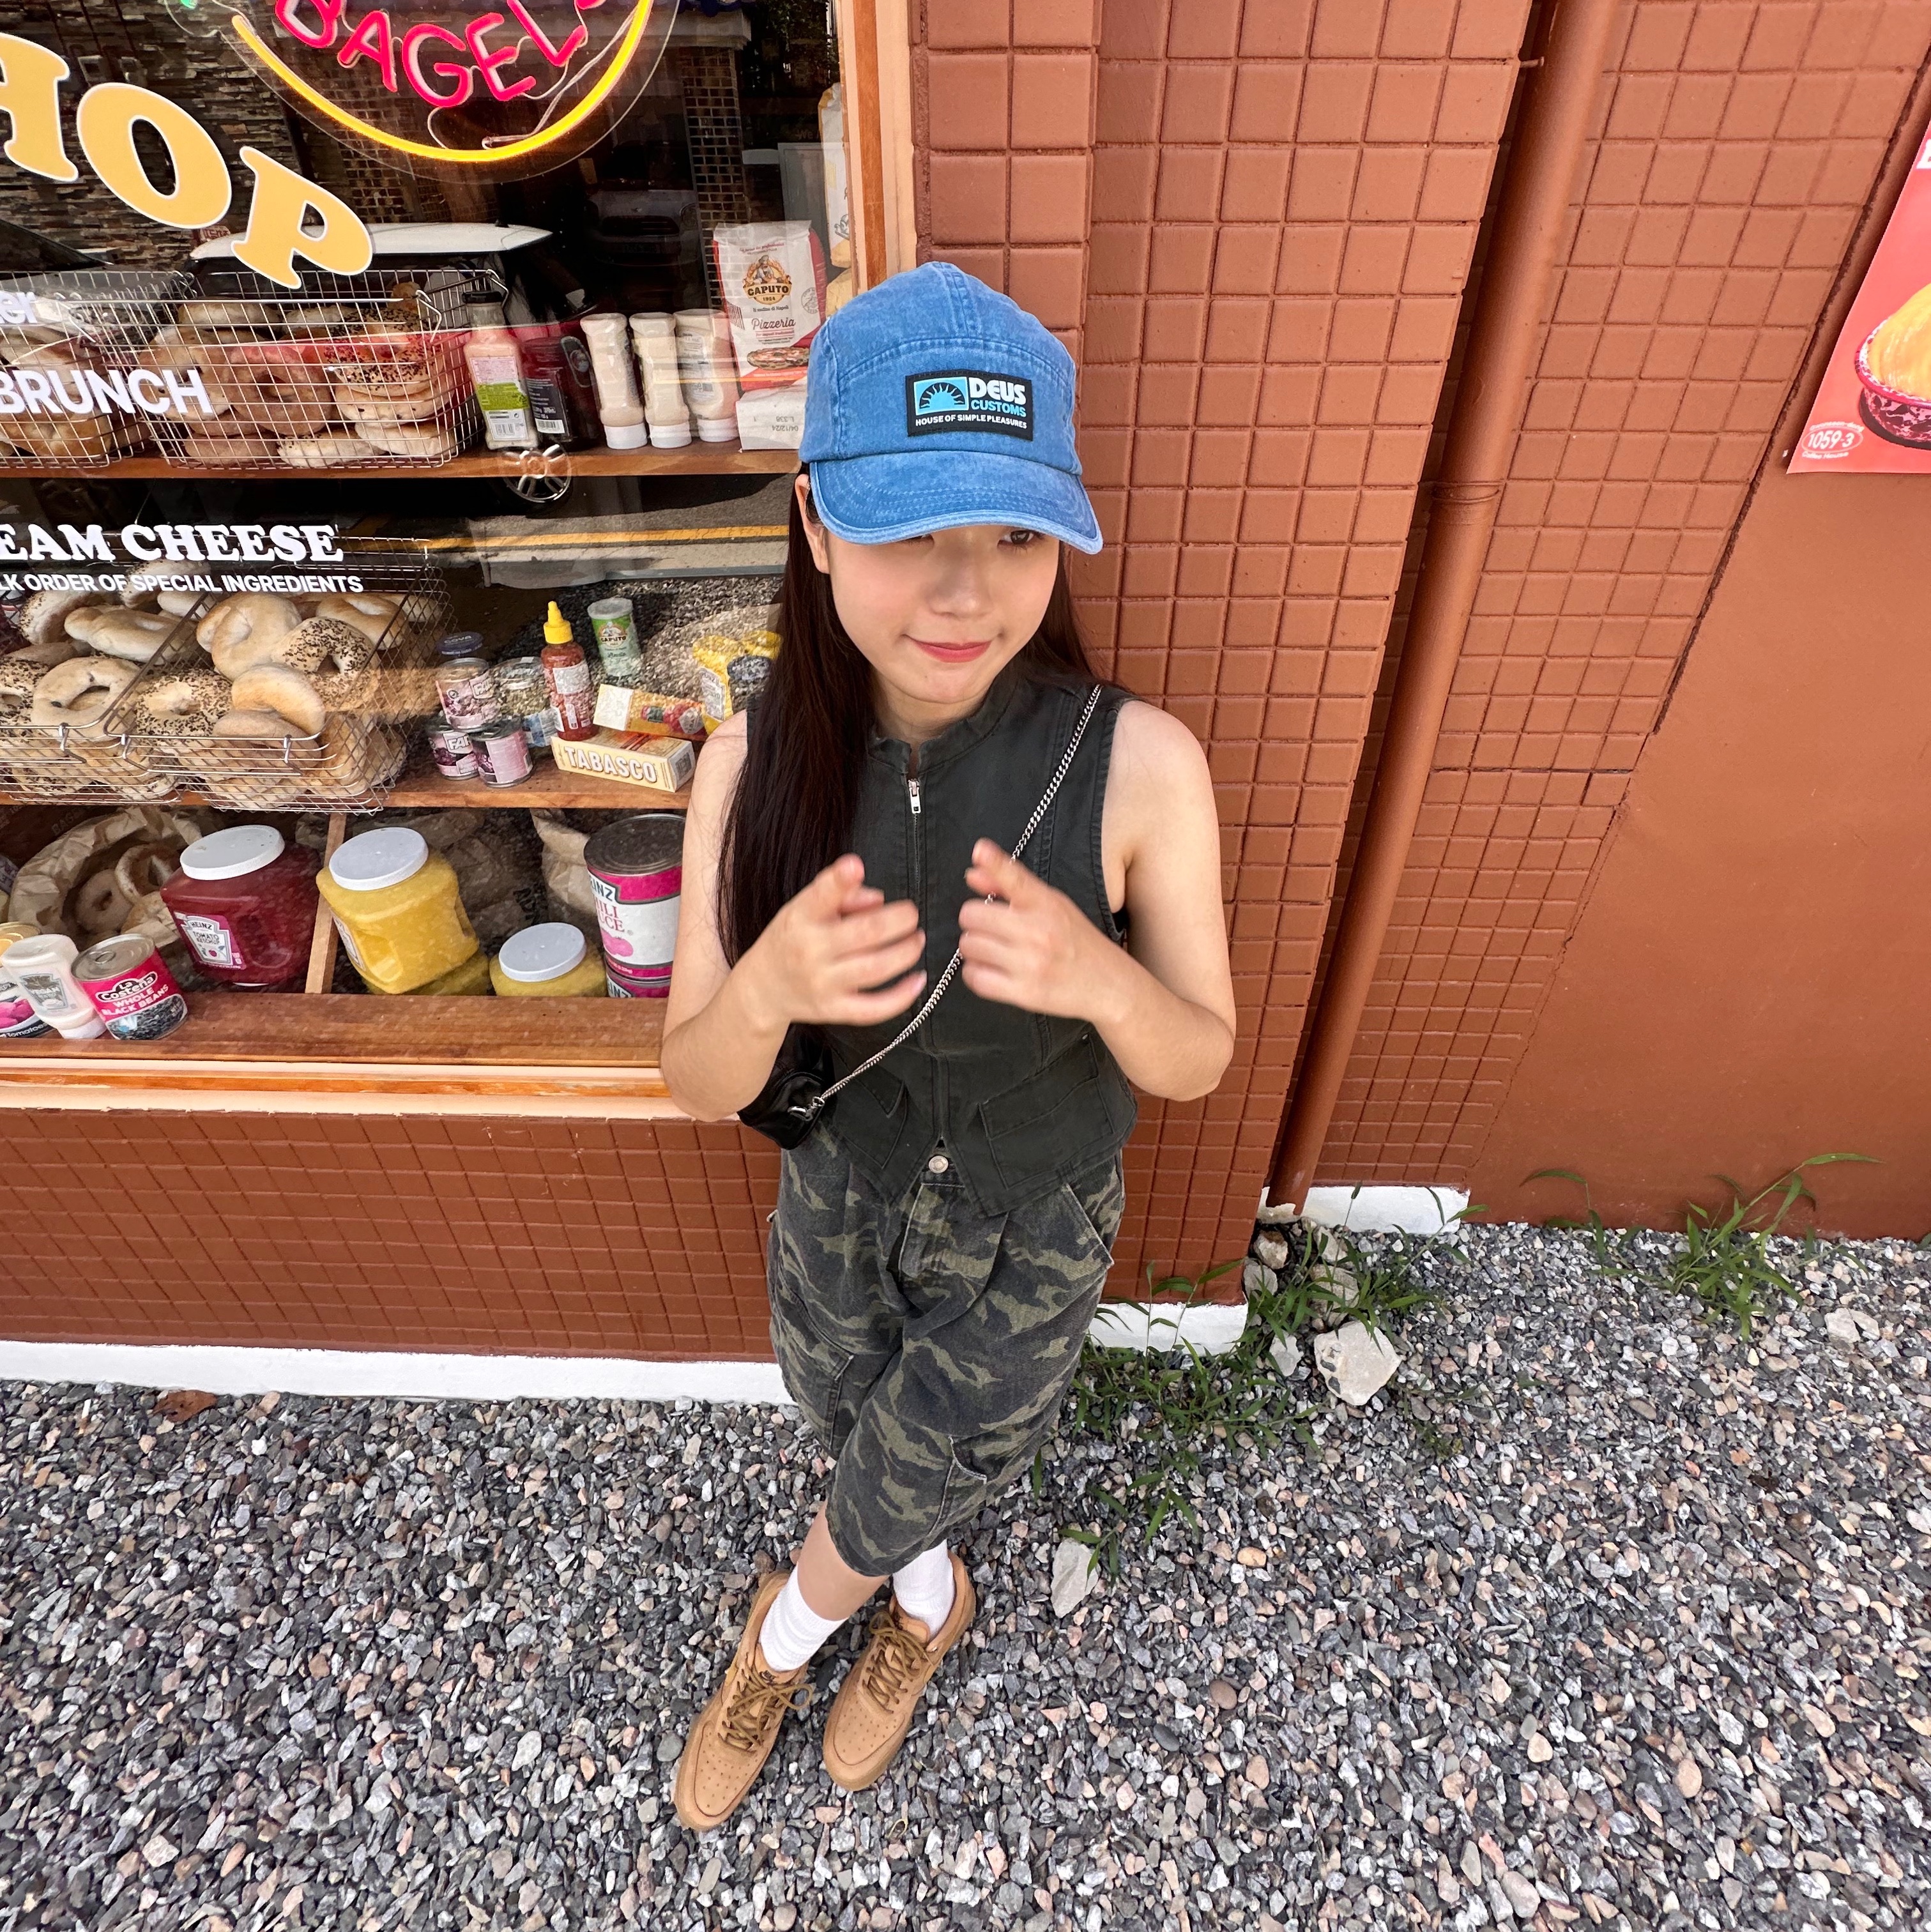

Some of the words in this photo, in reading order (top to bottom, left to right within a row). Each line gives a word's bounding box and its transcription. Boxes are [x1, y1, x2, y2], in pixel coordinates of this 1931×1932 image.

[747, 285, 790, 296] CAPUTO
[751, 317, 796, 330] Pizzeria
[968, 377, 1027, 406] DEUS
[970, 399, 1027, 418] CUSTOMS
[915, 415, 944, 427] HOUSE
[945, 414, 956, 422] OF
[957, 414, 986, 422] SIMPLE
[986, 415, 1027, 429] PLEASURES
[1808, 430, 1855, 450] 1059-3
[121, 523, 344, 562] CHEESE
[24, 574, 99, 592] ORDER
[98, 574, 126, 592] OF
[131, 575, 222, 593] SPECIAL
[222, 575, 363, 593] INGREDIENTS
[564, 746, 657, 783] TABASCO
[191, 922, 213, 930] HEINZ
[192, 931, 220, 941] TOMATO
[118, 982, 133, 990] La
[101, 1004, 138, 1015] BLACK
[138, 984, 169, 1008] BEANS
[113, 987, 155, 1008] WHOLE
